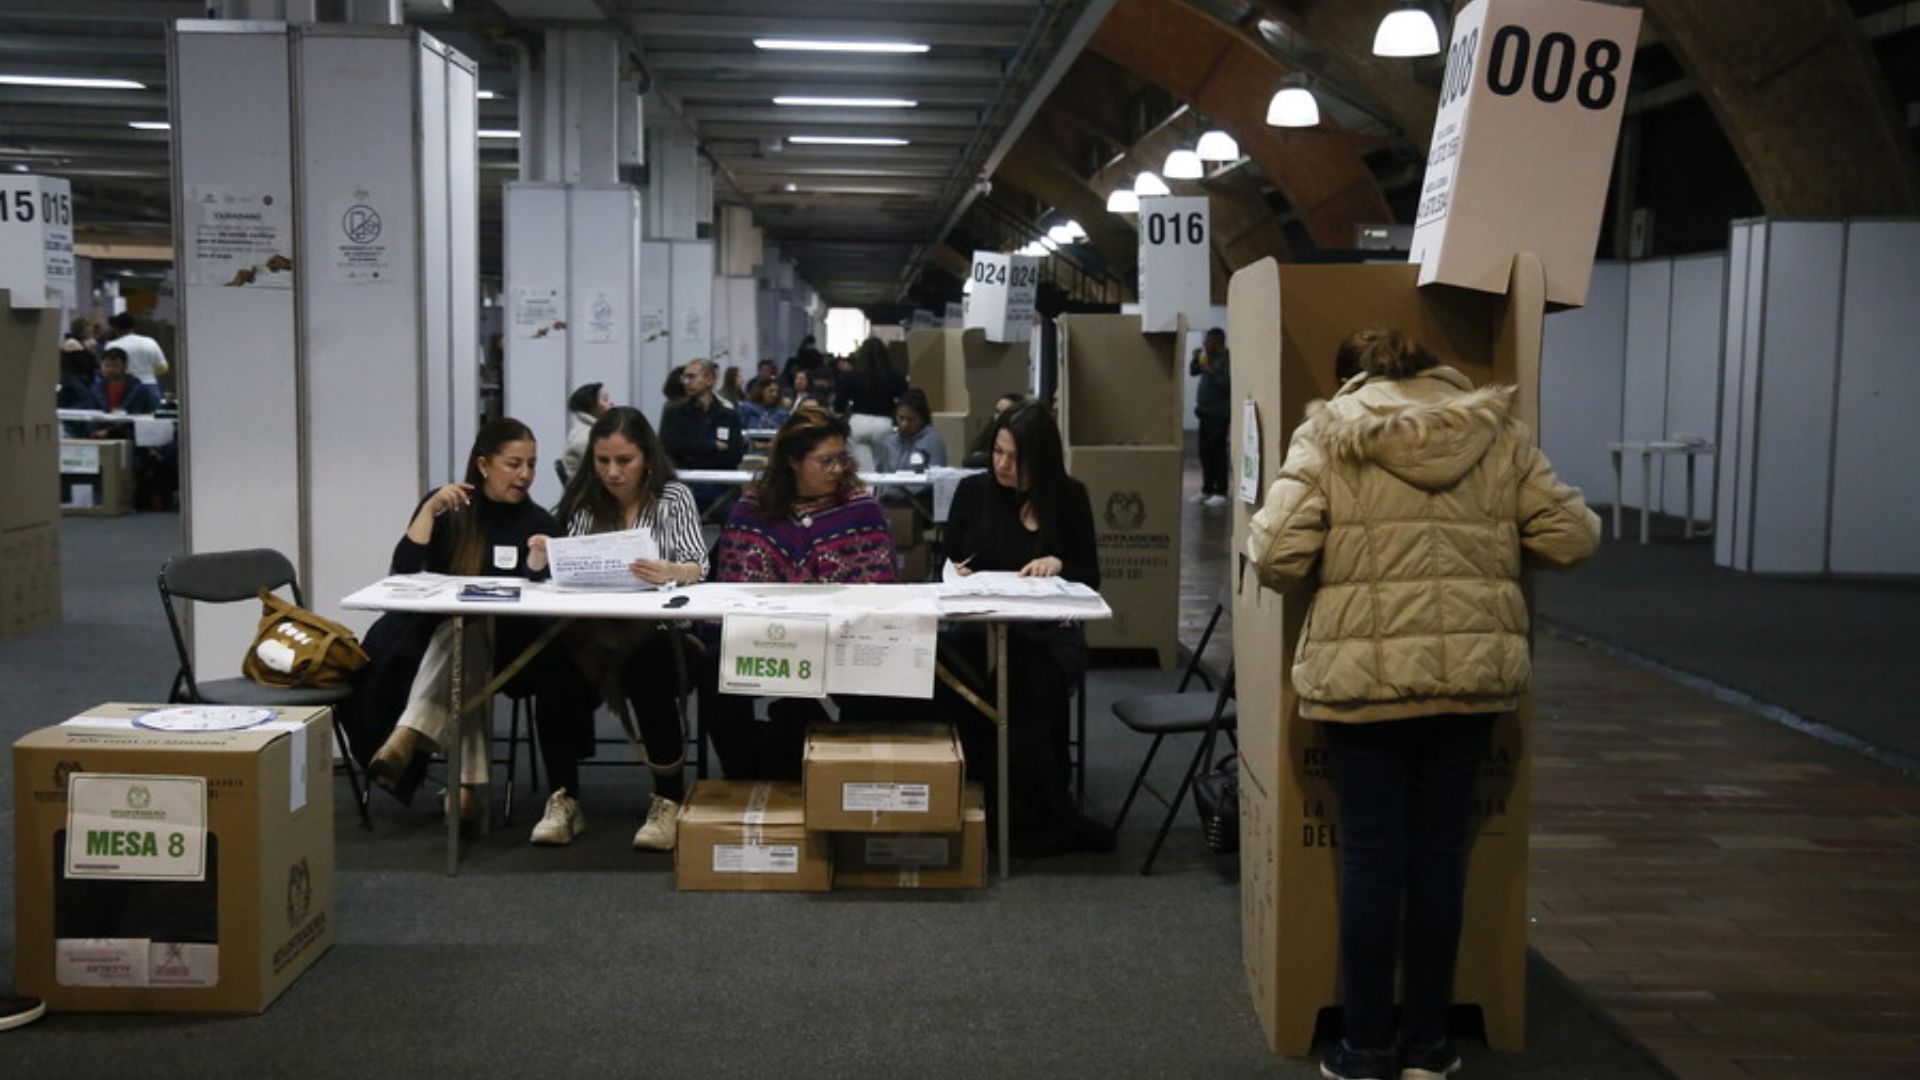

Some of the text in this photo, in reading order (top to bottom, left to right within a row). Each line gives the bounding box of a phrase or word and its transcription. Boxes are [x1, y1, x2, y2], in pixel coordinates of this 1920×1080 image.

[1487, 25, 1621, 110] 008
[42, 192, 69, 225] 015
[1149, 213, 1204, 244] 016
[974, 260, 1006, 287] 024
[1011, 265, 1036, 287] 024
[736, 656, 811, 679] MESA 8
[86, 830, 185, 857] MESA 8
[1303, 824, 1340, 848] DEL
